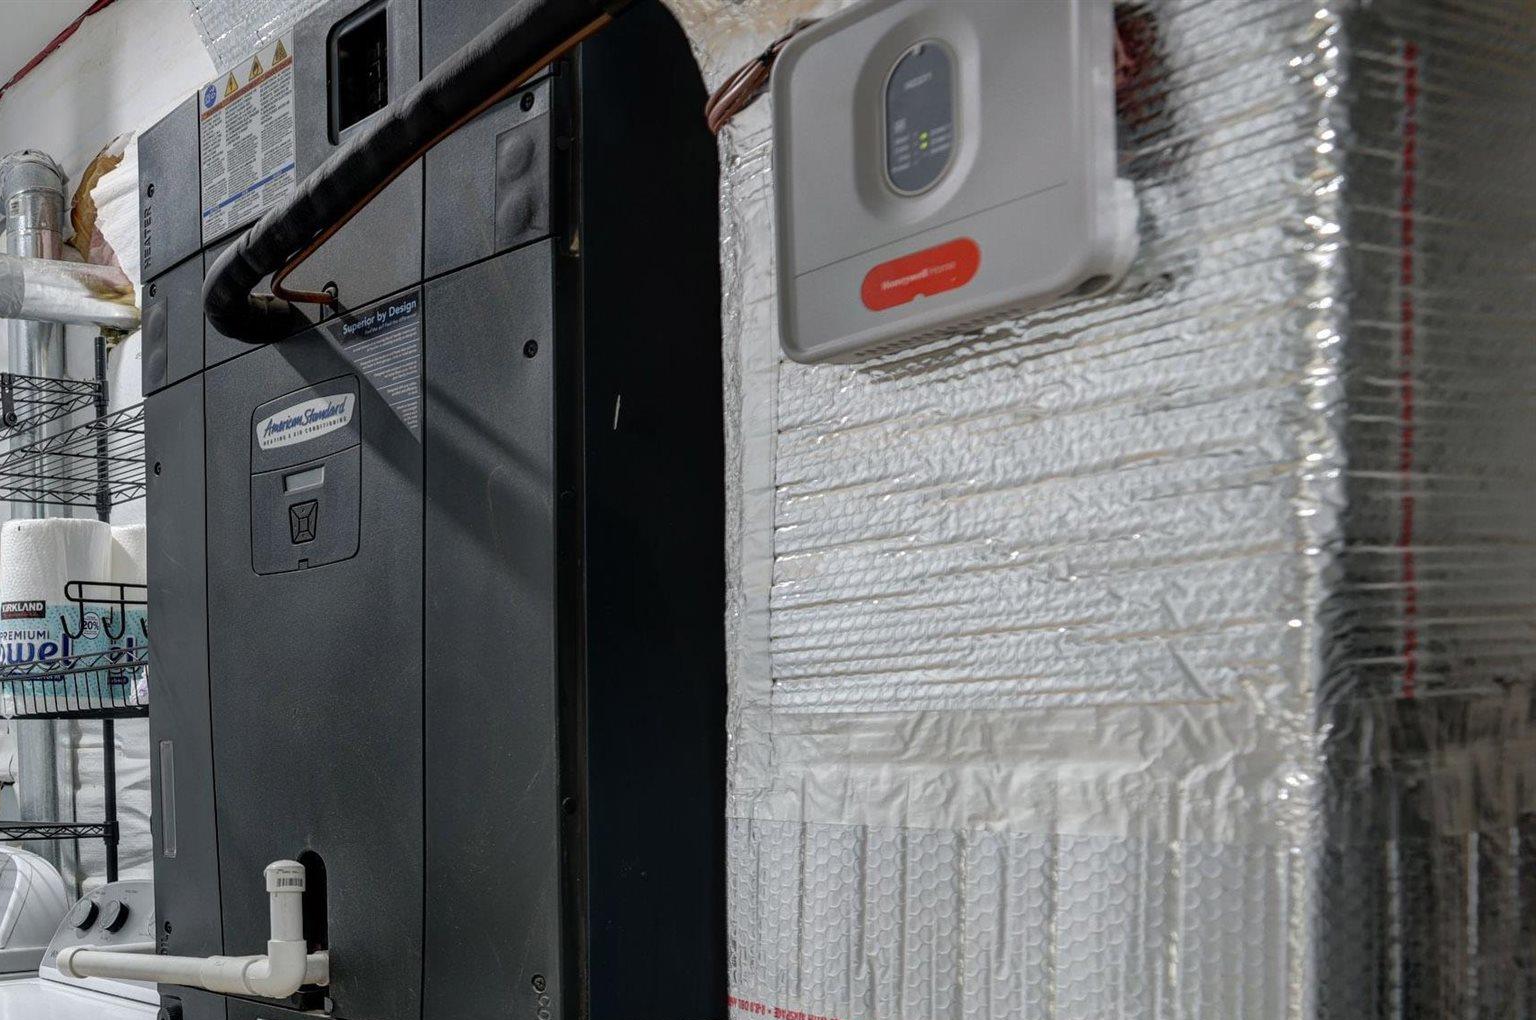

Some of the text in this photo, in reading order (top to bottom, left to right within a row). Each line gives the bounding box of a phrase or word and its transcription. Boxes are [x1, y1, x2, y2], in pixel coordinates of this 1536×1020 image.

[144, 206, 152, 270] HEATER
[882, 268, 928, 291] Honeywell
[343, 315, 374, 335] Superior
[376, 310, 387, 323] by
[388, 300, 417, 317] Design
[263, 396, 346, 438] American Standard
